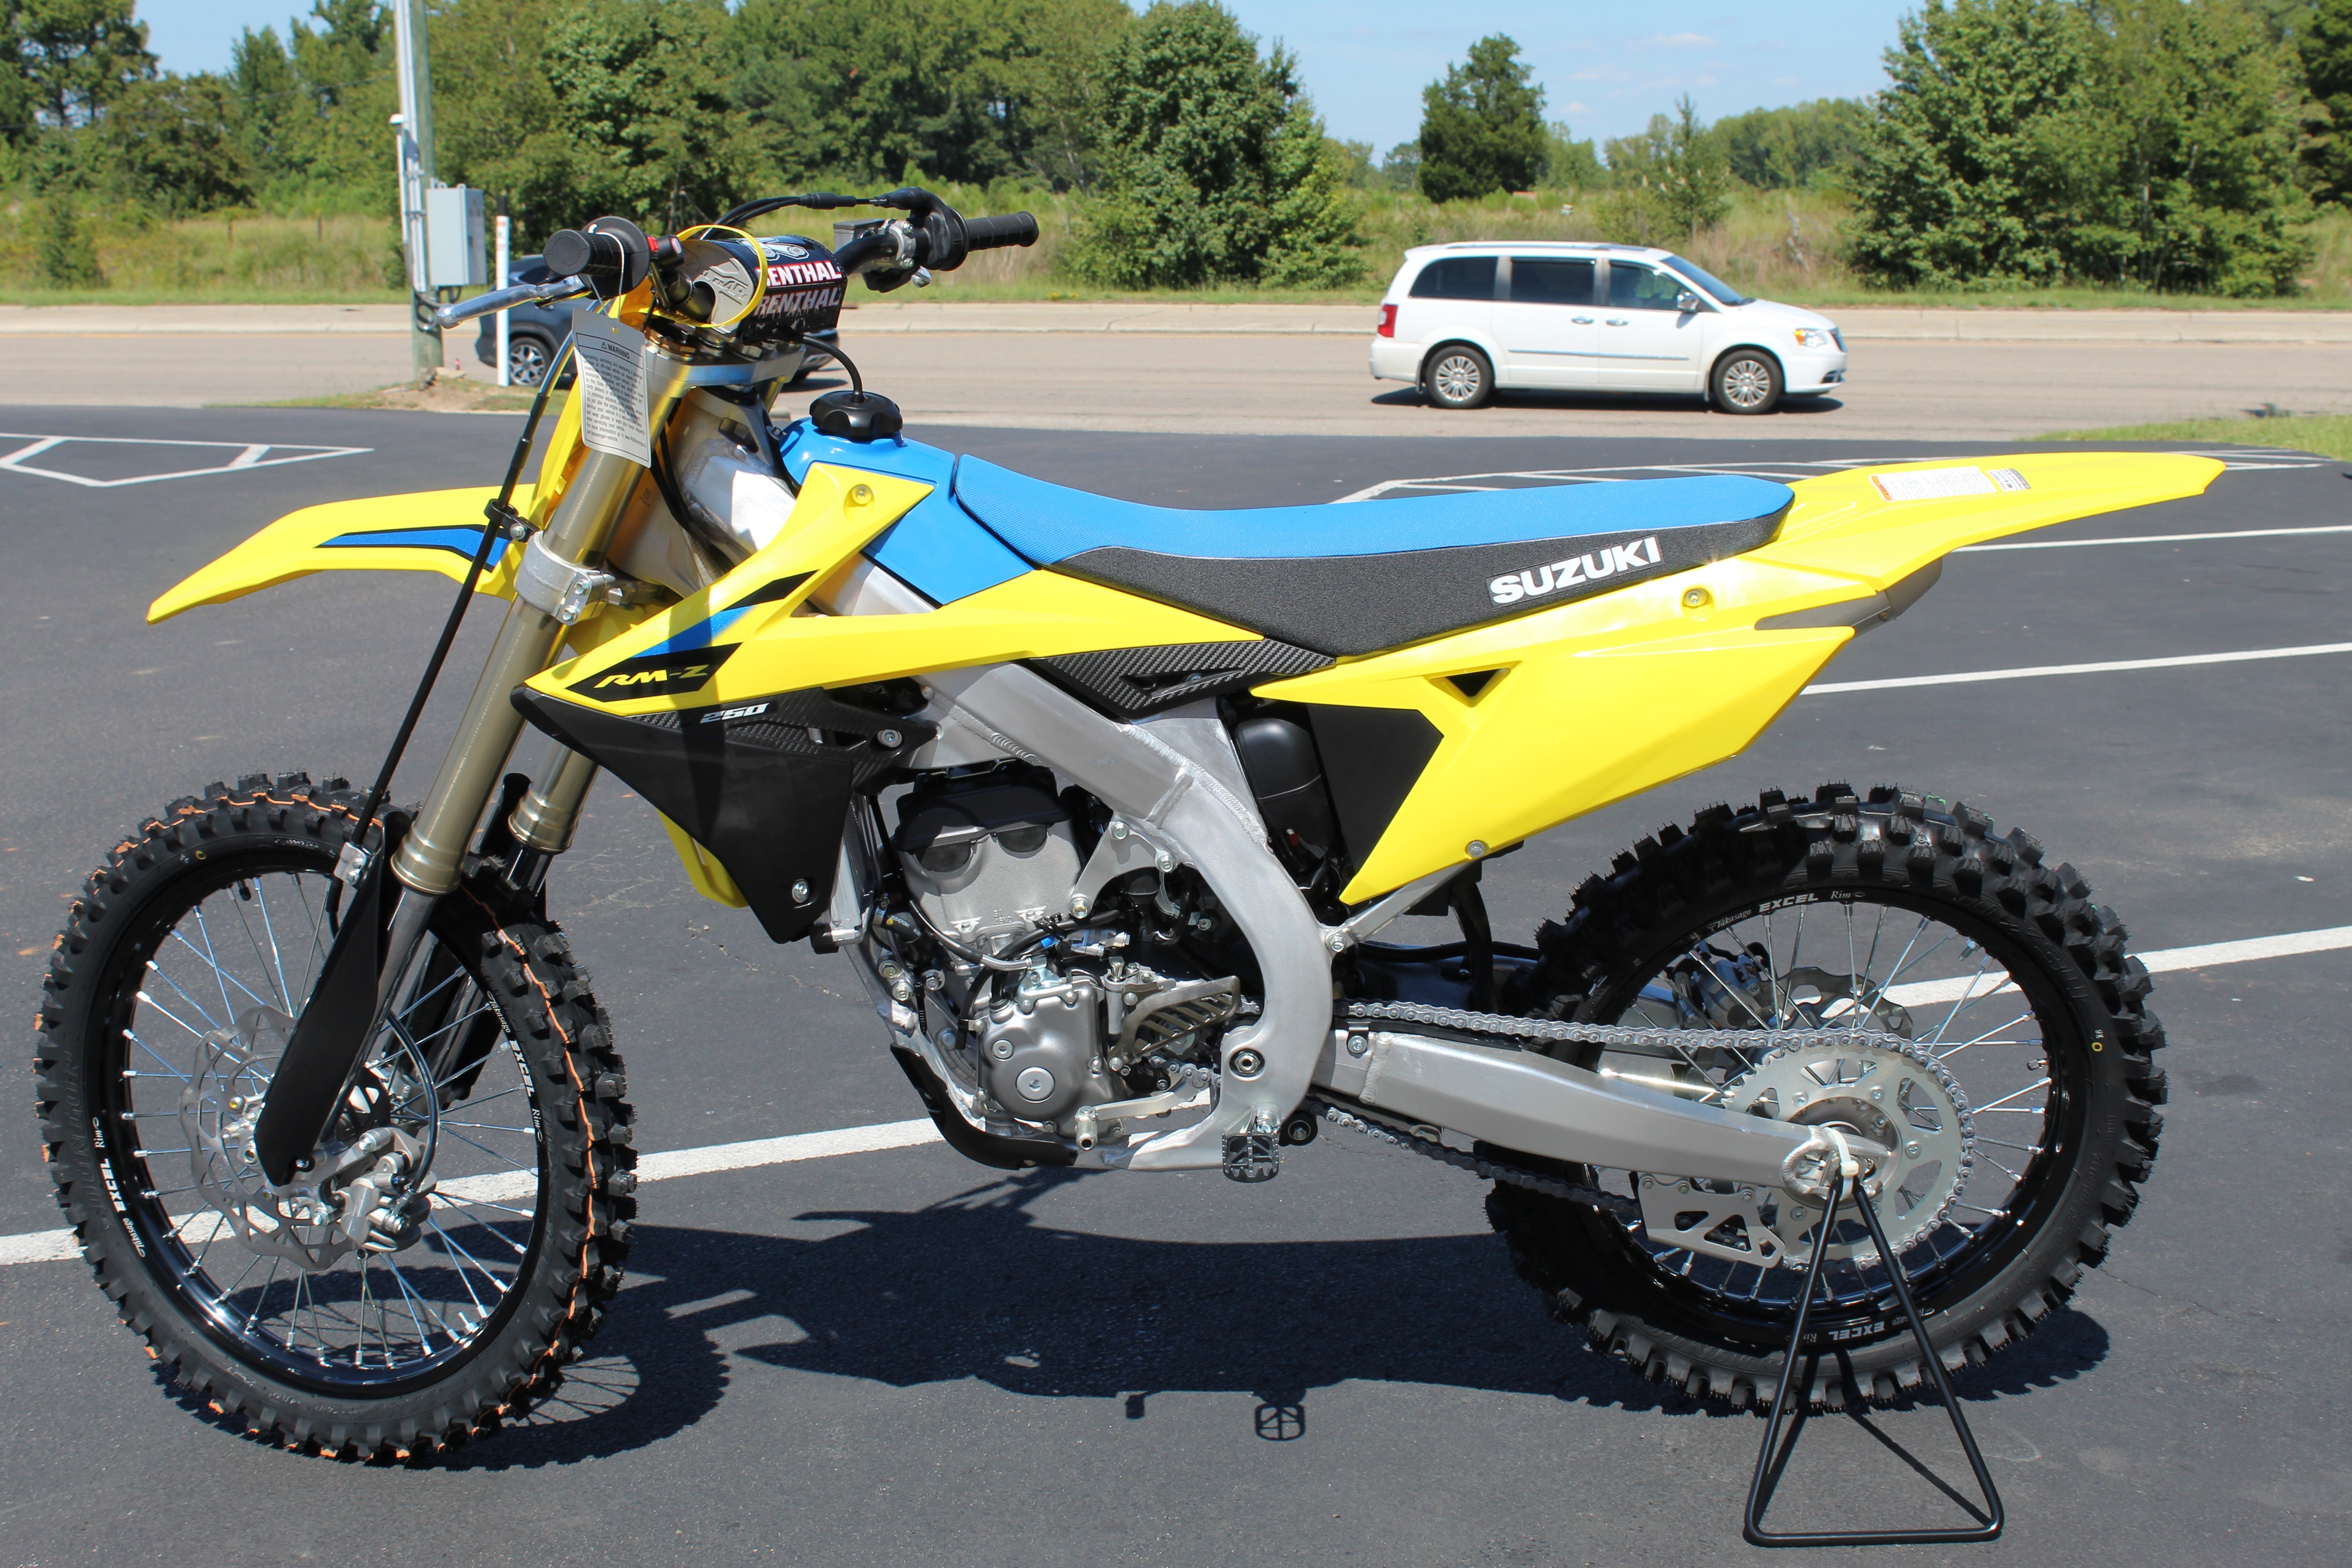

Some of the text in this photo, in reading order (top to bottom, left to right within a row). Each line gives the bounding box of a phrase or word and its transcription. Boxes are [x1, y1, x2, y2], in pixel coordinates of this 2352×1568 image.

[608, 344, 630, 359] WARNING
[1490, 536, 1662, 603] SUZUKI
[593, 664, 710, 688] RM-Z
[700, 702, 770, 724] 250
[1707, 890, 1860, 931] Takasago EXCEL Rim
[487, 991, 542, 1137] Takasago EXCEL Rim
[93, 1122, 146, 1258] Takasago EXCEL Rim
[1828, 1321, 1886, 1341] EXCEL
